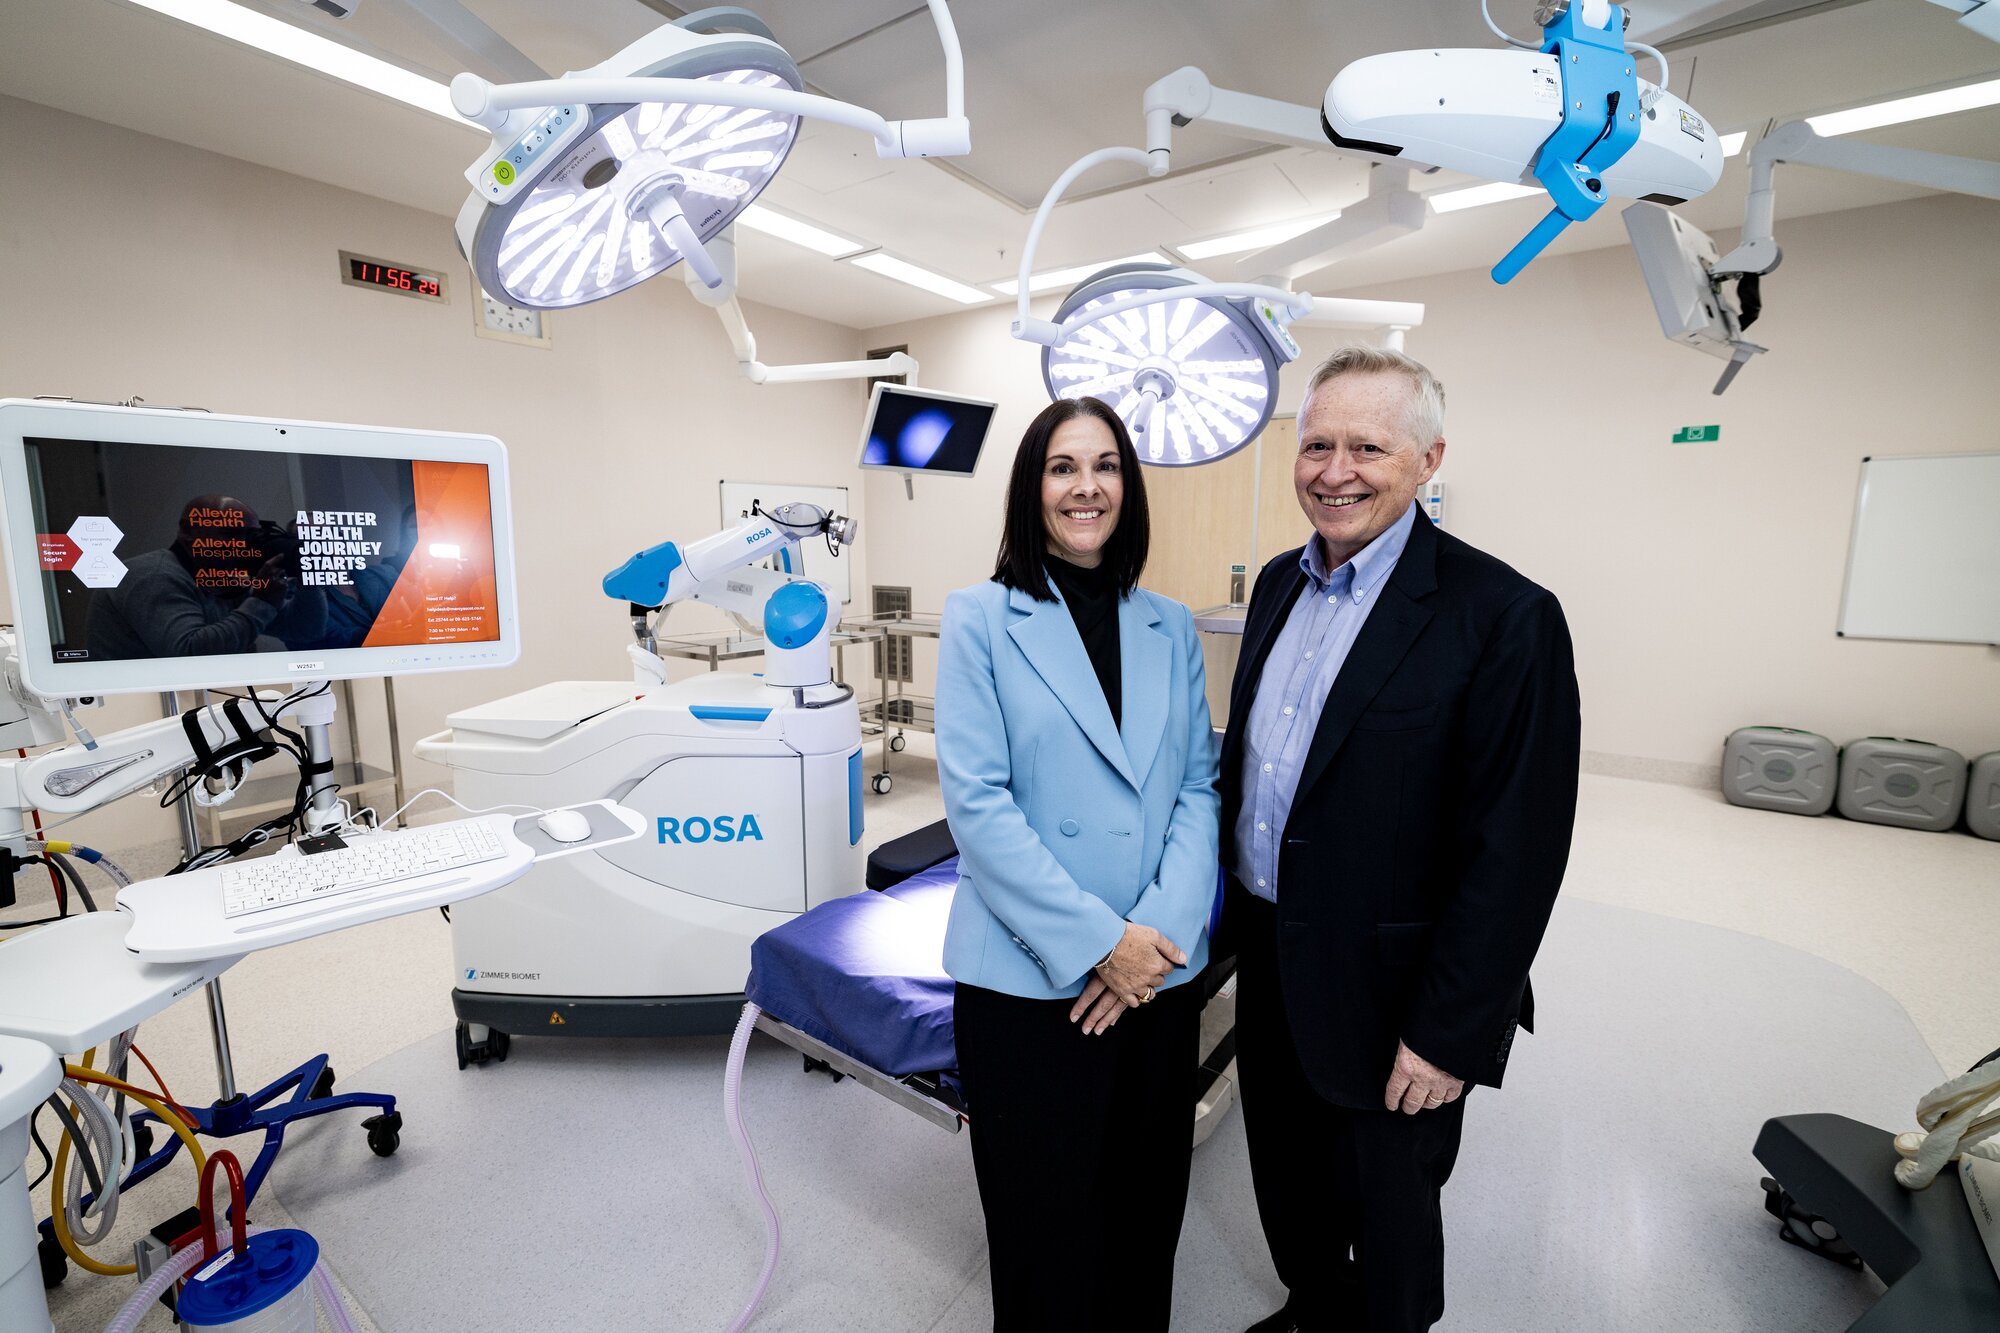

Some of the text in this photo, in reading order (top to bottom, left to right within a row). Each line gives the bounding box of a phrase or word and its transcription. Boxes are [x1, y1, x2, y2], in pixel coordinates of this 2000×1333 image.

[418, 279, 438, 295] 29
[188, 507, 243, 518] Allevia
[296, 510, 377, 526] A BETTER
[190, 518, 245, 528] Health
[297, 526, 363, 541] HEALTH
[746, 527, 772, 544] ROSA
[192, 538, 246, 548] Allevia
[299, 541, 382, 556] JOURNEY
[192, 548, 262, 560] Hospitals
[300, 556, 367, 571] STARTS
[195, 568, 248, 578] Allevia
[302, 571, 354, 586] HERE.
[196, 577, 270, 589] Radiology
[657, 814, 764, 844] ROSA
[312, 883, 337, 892] GETT
[480, 971, 541, 981] ZIMMER BIOMET
